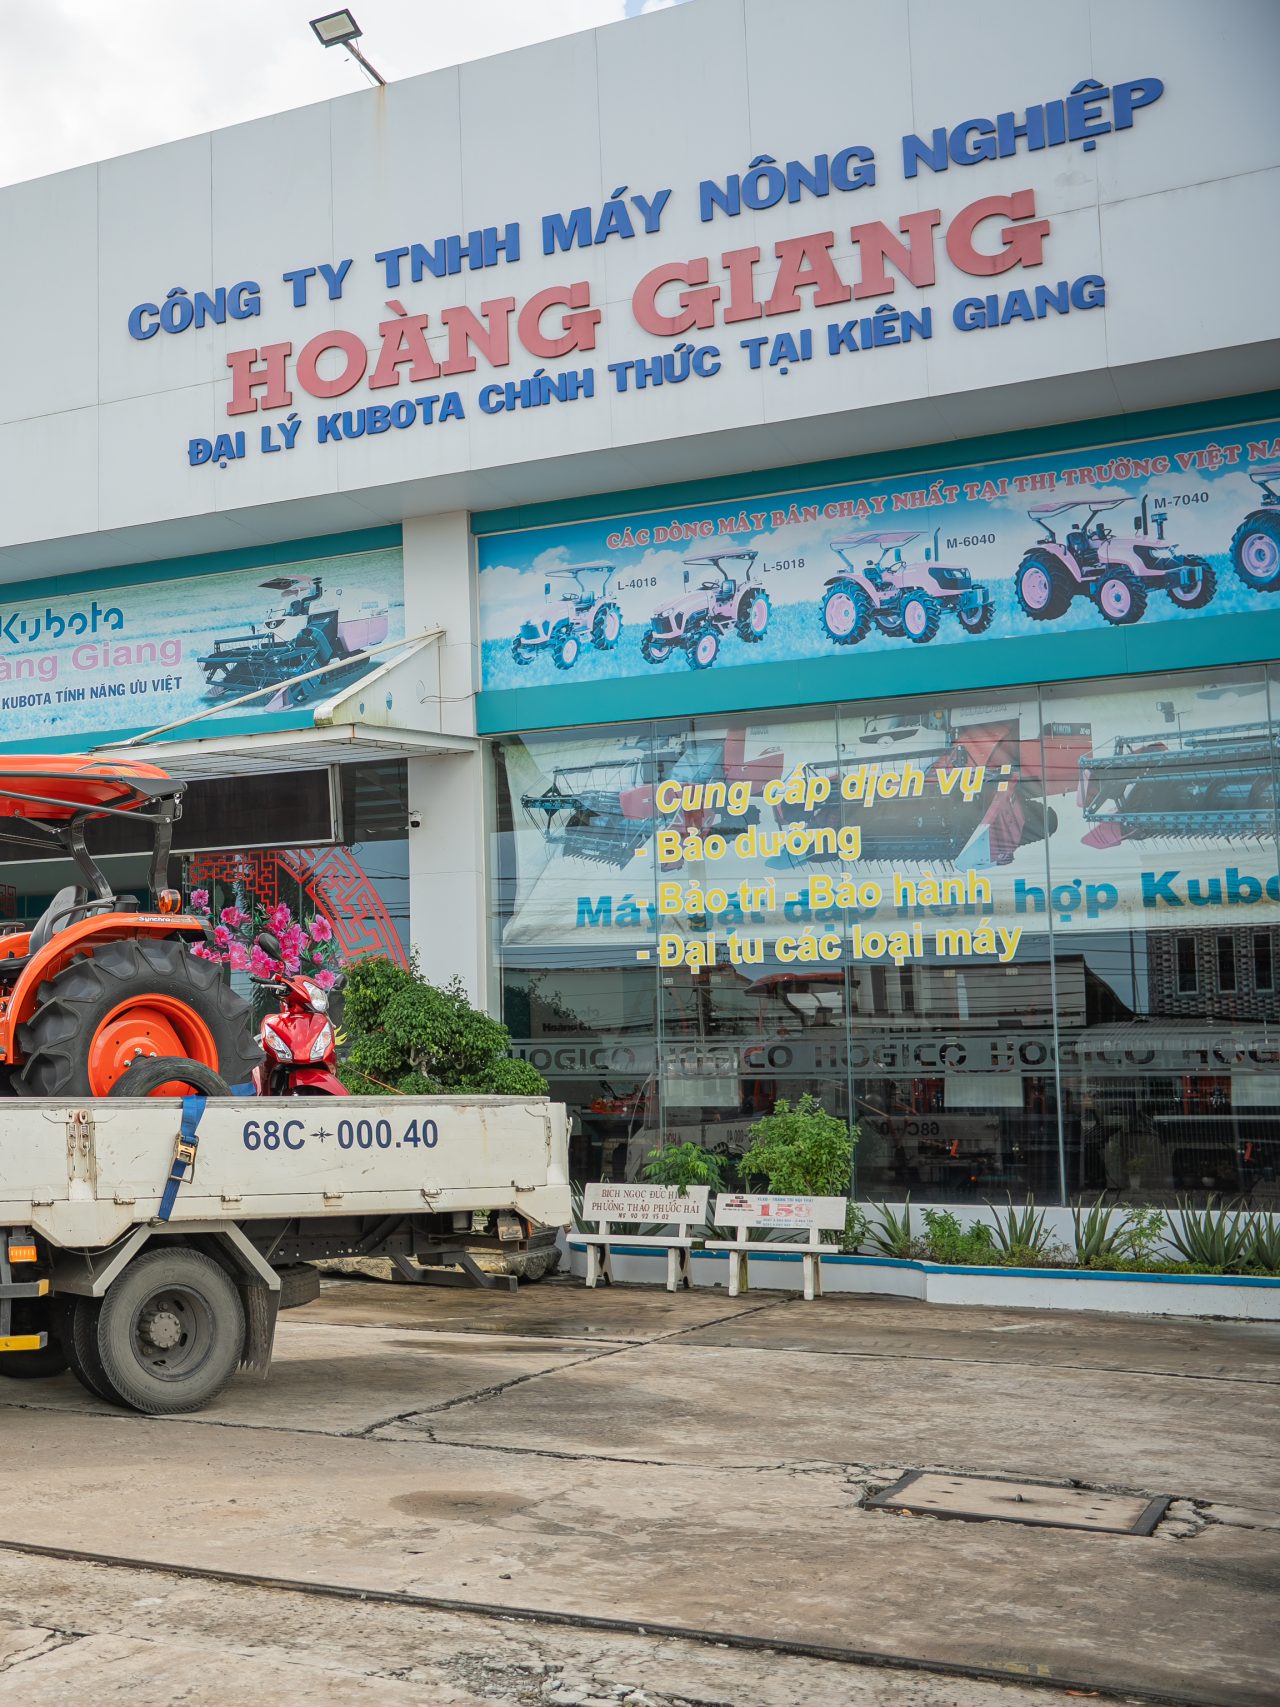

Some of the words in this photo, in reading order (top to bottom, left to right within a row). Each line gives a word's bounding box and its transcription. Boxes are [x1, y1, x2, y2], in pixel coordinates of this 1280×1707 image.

[127, 279, 262, 342] CÔNG
[283, 257, 353, 309] TY
[375, 220, 520, 288] TNHH
[541, 186, 672, 255] MÁY
[698, 152, 876, 222] NÔNG
[901, 76, 1165, 179] NGHIỆP
[226, 280, 601, 416] HOÀNG
[631, 188, 1051, 338] GIANG
[187, 431, 246, 467] ĐẠI
[260, 419, 301, 453] LÝ
[317, 390, 465, 444] KUBOTA
[478, 367, 596, 414] CHÍNH
[607, 341, 721, 393] THỨC
[740, 328, 813, 376] TẠI
[827, 305, 933, 357] KIÊN
[953, 273, 1107, 333] GIANG
[607, 527, 650, 550] CÁC
[654, 520, 714, 544] DÒNG
[718, 512, 767, 538] MÁY
[770, 503, 819, 529] BÁN
[823, 496, 887, 521] CHẠY
[891, 480, 960, 512] NHẤT
[964, 477, 1009, 503] TẠI
[1014, 471, 1057, 493] THỊ
[1061, 455, 1171, 487] TRƯỜNG
[1175, 443, 1242, 471] VIỆT
[1154, 491, 1210, 509] M-7040
[946, 533, 996, 550] M-6040
[617, 577, 657, 591] L-4018
[763, 558, 805, 573] L-5018
[71, 638, 182, 671] Giang
[2, 691, 52, 710] KUBOTA
[56, 685, 85, 703] TÍNH
[90, 682, 126, 699] NĂNG
[129, 677, 148, 695] ƯU
[152, 674, 183, 692] VIỆT
[655, 779, 752, 816] Cung
[763, 761, 831, 812] cấp
[841, 761, 925, 808] dịch
[936, 765, 985, 803] vụ
[657, 827, 727, 864] Bảo
[734, 822, 862, 861] dưỡng
[657, 880, 728, 915] Bảo
[738, 876, 777, 912] trì
[808, 872, 882, 910] Bảo
[893, 868, 992, 907] hành
[1013, 878, 1119, 923] hợp
[657, 932, 717, 975] Đại
[726, 931, 764, 965] tu
[774, 926, 842, 963] các
[851, 921, 924, 967] loại
[935, 917, 1024, 962] máy
[815, 1043, 967, 1068] HOGICO
